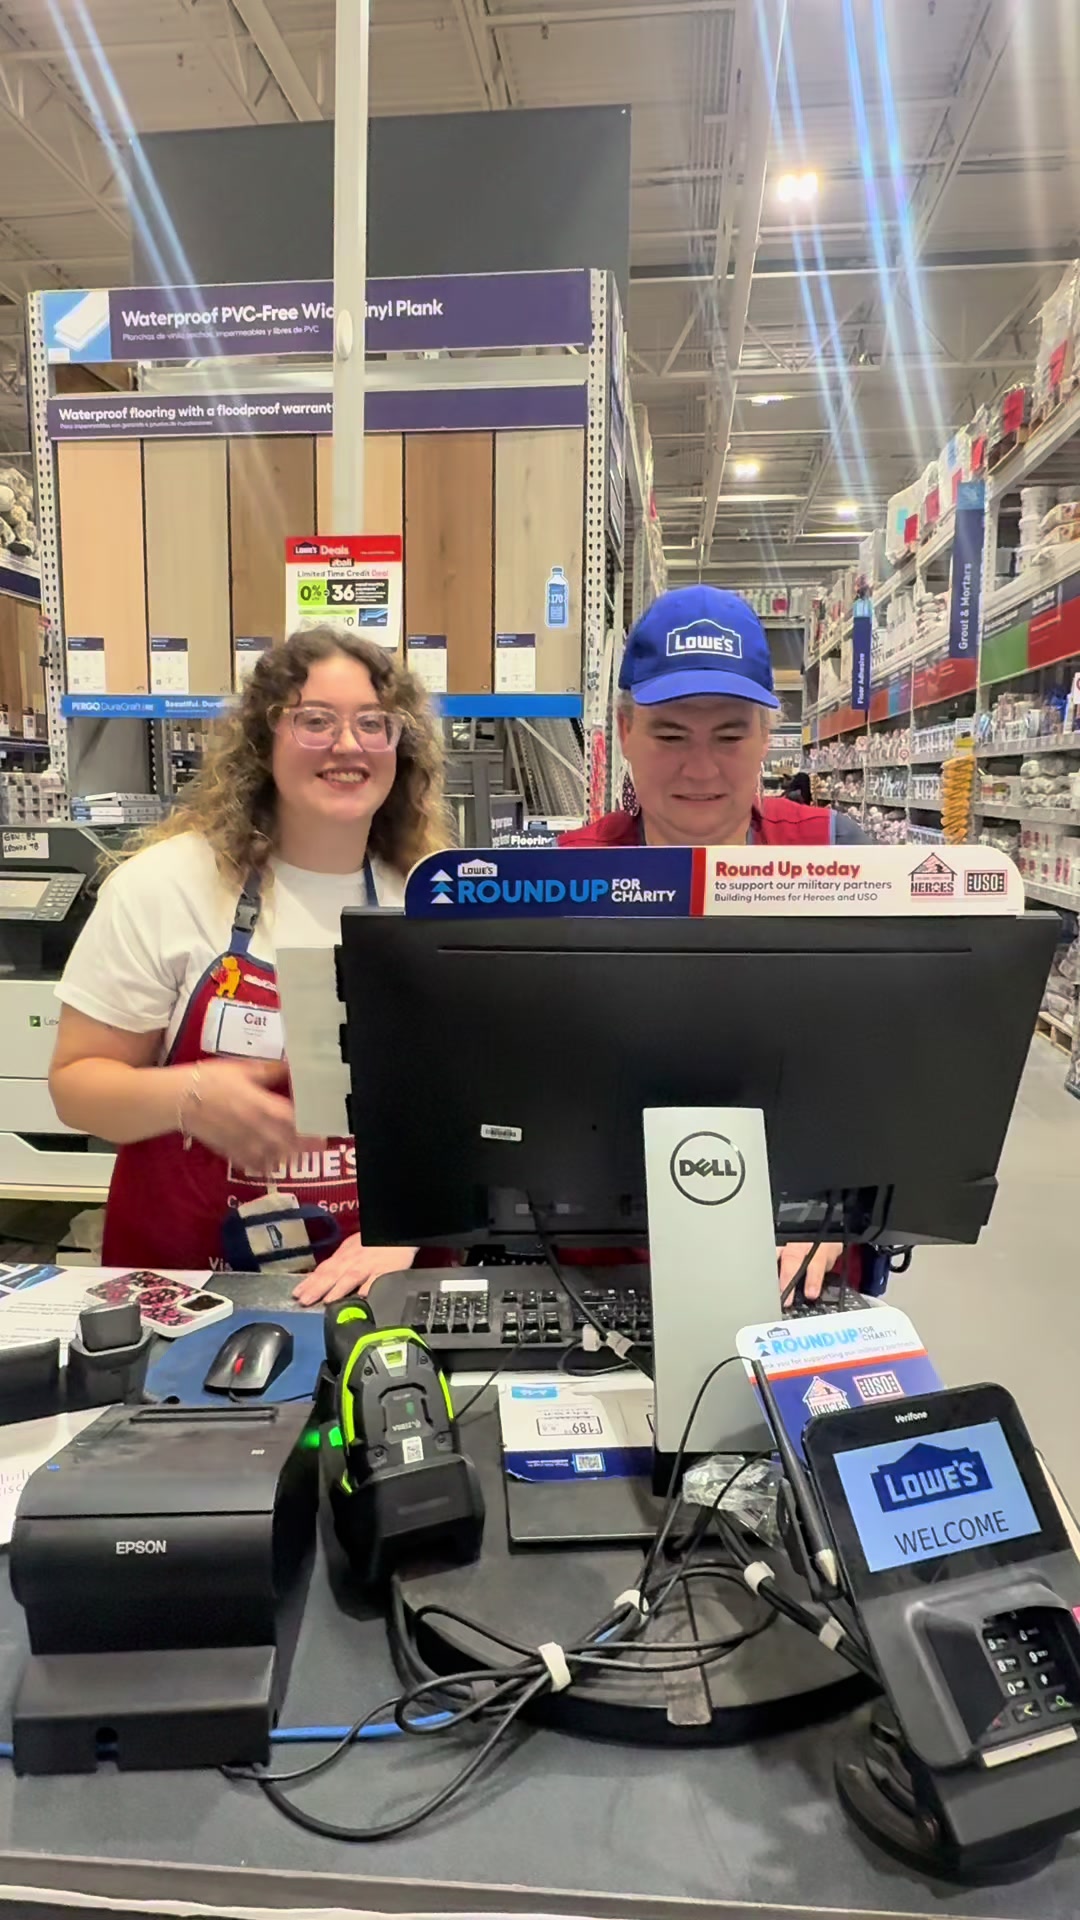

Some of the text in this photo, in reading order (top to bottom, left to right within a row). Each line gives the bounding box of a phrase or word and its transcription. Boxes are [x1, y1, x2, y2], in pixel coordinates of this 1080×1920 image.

[122, 306, 219, 329] Waterproof
[221, 304, 299, 323] PVC-Free
[364, 300, 393, 321] inyl
[396, 298, 444, 317] Plank
[304, 325, 319, 333] PVC
[59, 402, 333, 422] Waterproof flooring with a floodproof warrant
[320, 545, 350, 555] Deals
[297, 570, 326, 578] Limited
[346, 569, 370, 577] Credit
[371, 569, 389, 577] Deal
[300, 584, 322, 601] 0%
[331, 583, 355, 602] 36
[958, 563, 972, 651] Grout & Mortars
[674, 634, 734, 653] LOWE'S
[71, 702, 100, 711] PERGO
[511, 834, 552, 845] Floorin
[461, 866, 495, 875] LOWE'S
[716, 860, 861, 879] Round Up today
[611, 878, 641, 890] FOR
[714, 880, 892, 893] to support our military partners
[910, 882, 954, 893] HEROES
[973, 873, 998, 891] USO
[457, 879, 609, 903] ROUND UP
[611, 889, 676, 903] CHARITY
[714, 892, 878, 904] Building Homes for Heroes and USO
[244, 1012, 267, 1027] Cat
[679, 1157, 738, 1178] DELL
[859, 1325, 875, 1334] FOR
[862, 1329, 898, 1342] CHARITY
[771, 1327, 860, 1355] ROUND UP
[863, 1375, 892, 1396] USO
[894, 1411, 928, 1425] Verifone
[883, 1459, 979, 1504] LOWE'S
[894, 1510, 1009, 1556] WELCOME
[115, 1540, 167, 1555] EPSON
